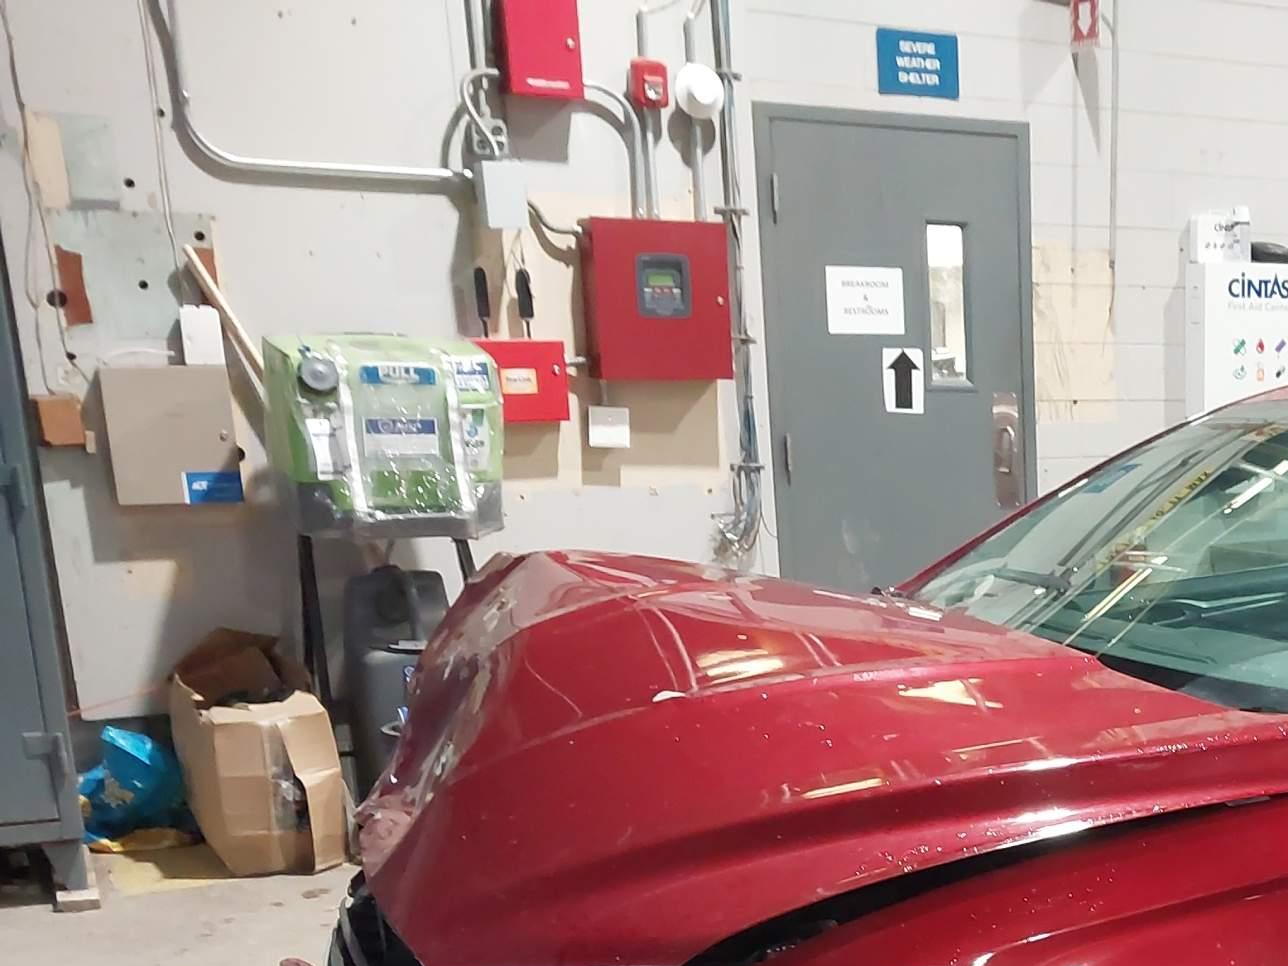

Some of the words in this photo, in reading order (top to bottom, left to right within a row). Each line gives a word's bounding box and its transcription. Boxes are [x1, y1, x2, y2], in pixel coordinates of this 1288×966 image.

[895, 56, 941, 71] WEATHER
[898, 71, 940, 86] SHELTER
[1248, 301, 1262, 310] Aid
